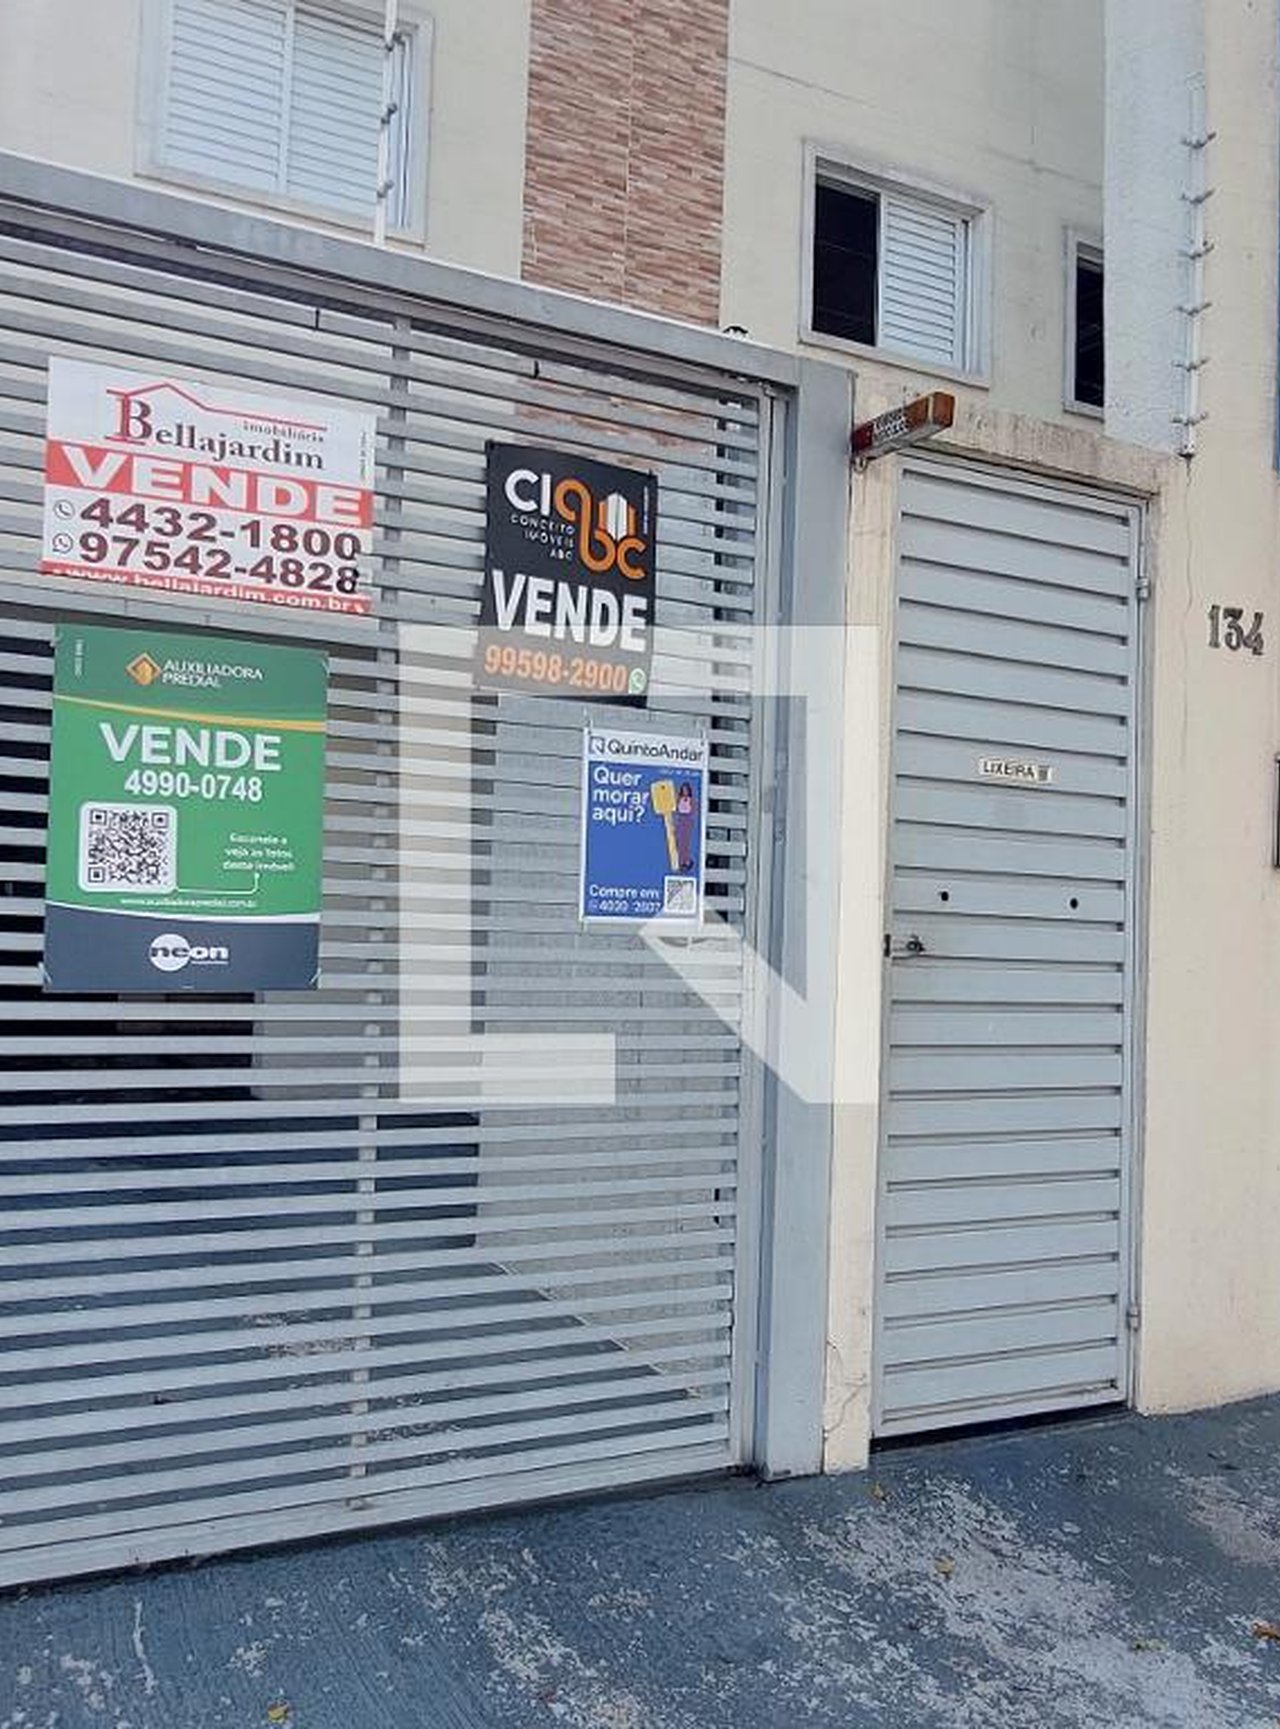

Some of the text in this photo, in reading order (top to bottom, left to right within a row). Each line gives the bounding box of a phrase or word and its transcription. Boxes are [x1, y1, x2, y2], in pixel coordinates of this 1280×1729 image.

[106, 390, 325, 470] Bellajardim
[61, 447, 363, 526] VENDE
[80, 498, 361, 561] 4432-1800
[79, 532, 359, 594] 97542-4828
[491, 569, 647, 652] VENDE
[1207, 603, 1265, 656] 134
[163, 660, 264, 680] AUXILIADORA
[484, 644, 629, 691] 99598-2900
[100, 723, 281, 771] VENDE
[607, 738, 704, 762] QuintoAndar
[593, 766, 642, 786] Quer
[983, 761, 1035, 778] LIXEIRA
[124, 770, 263, 801] 4990-0748
[592, 788, 650, 805] morar
[592, 805, 645, 826] aqui?
[640, 888, 660, 899] em
[150, 946, 229, 960] neon
